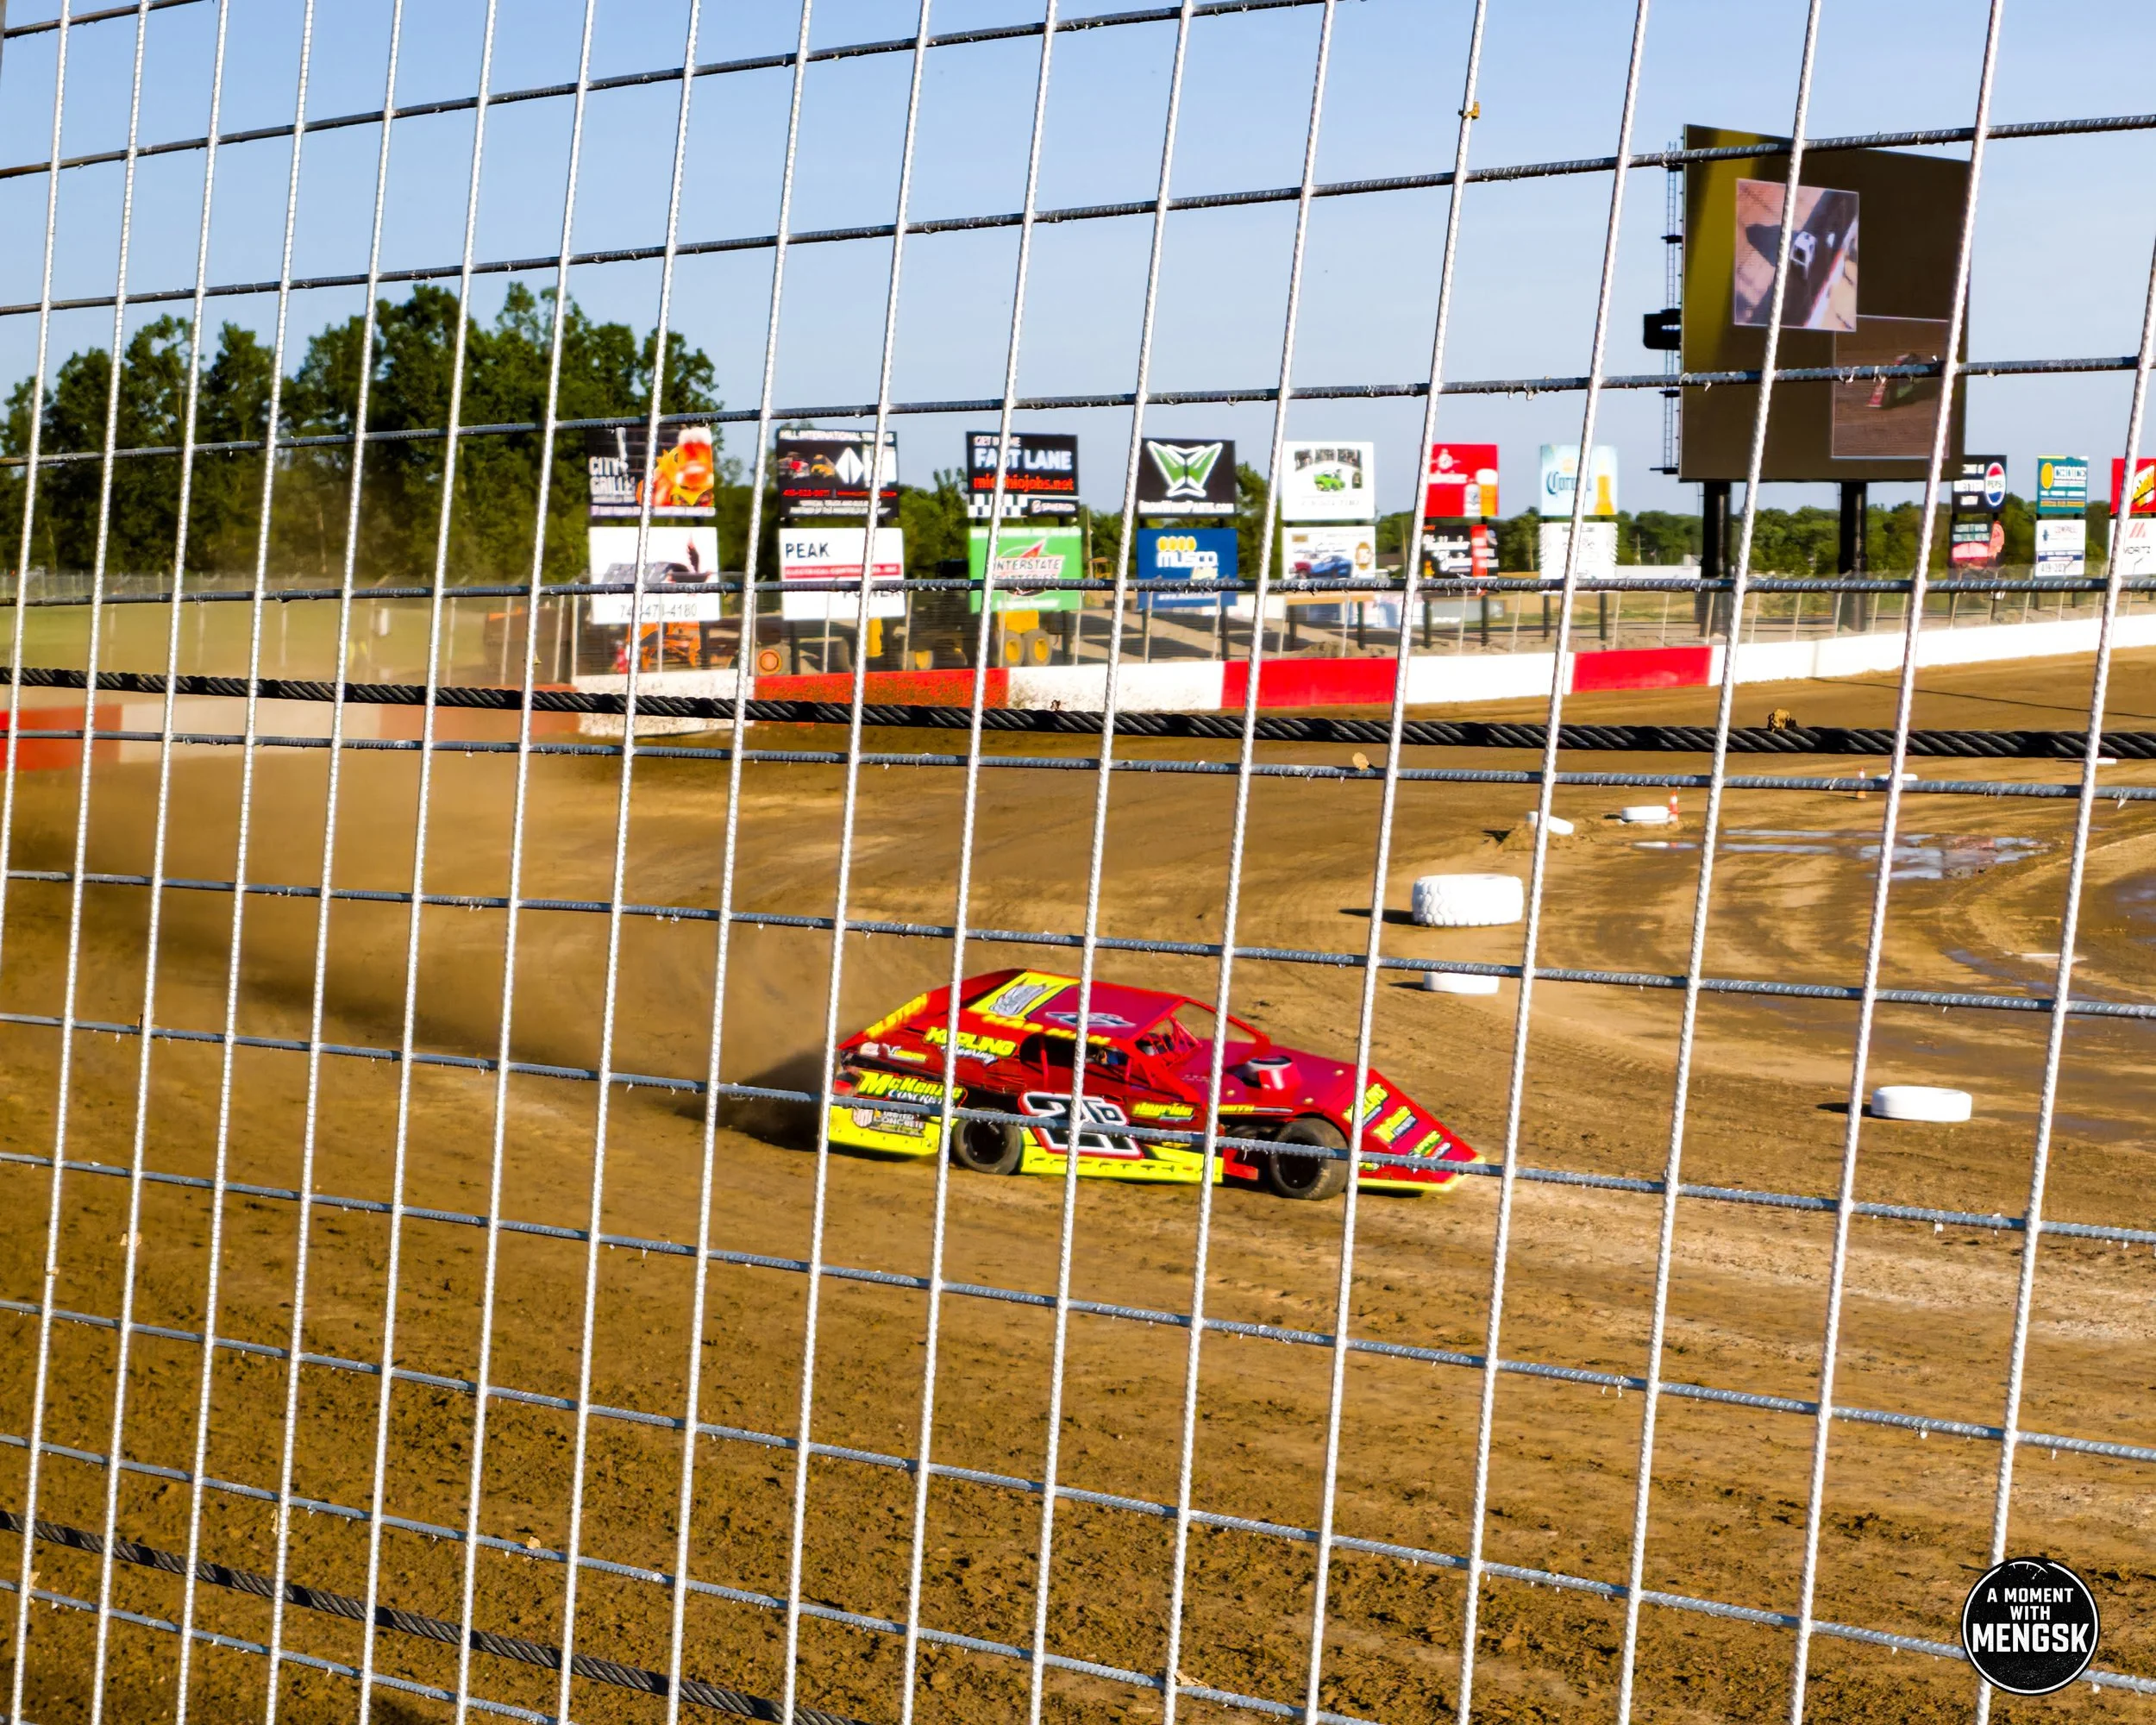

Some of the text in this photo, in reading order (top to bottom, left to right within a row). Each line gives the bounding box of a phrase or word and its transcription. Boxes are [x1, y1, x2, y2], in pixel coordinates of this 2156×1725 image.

[974, 448, 1072, 470] FAT LANE
[786, 543, 830, 559] PEAK
